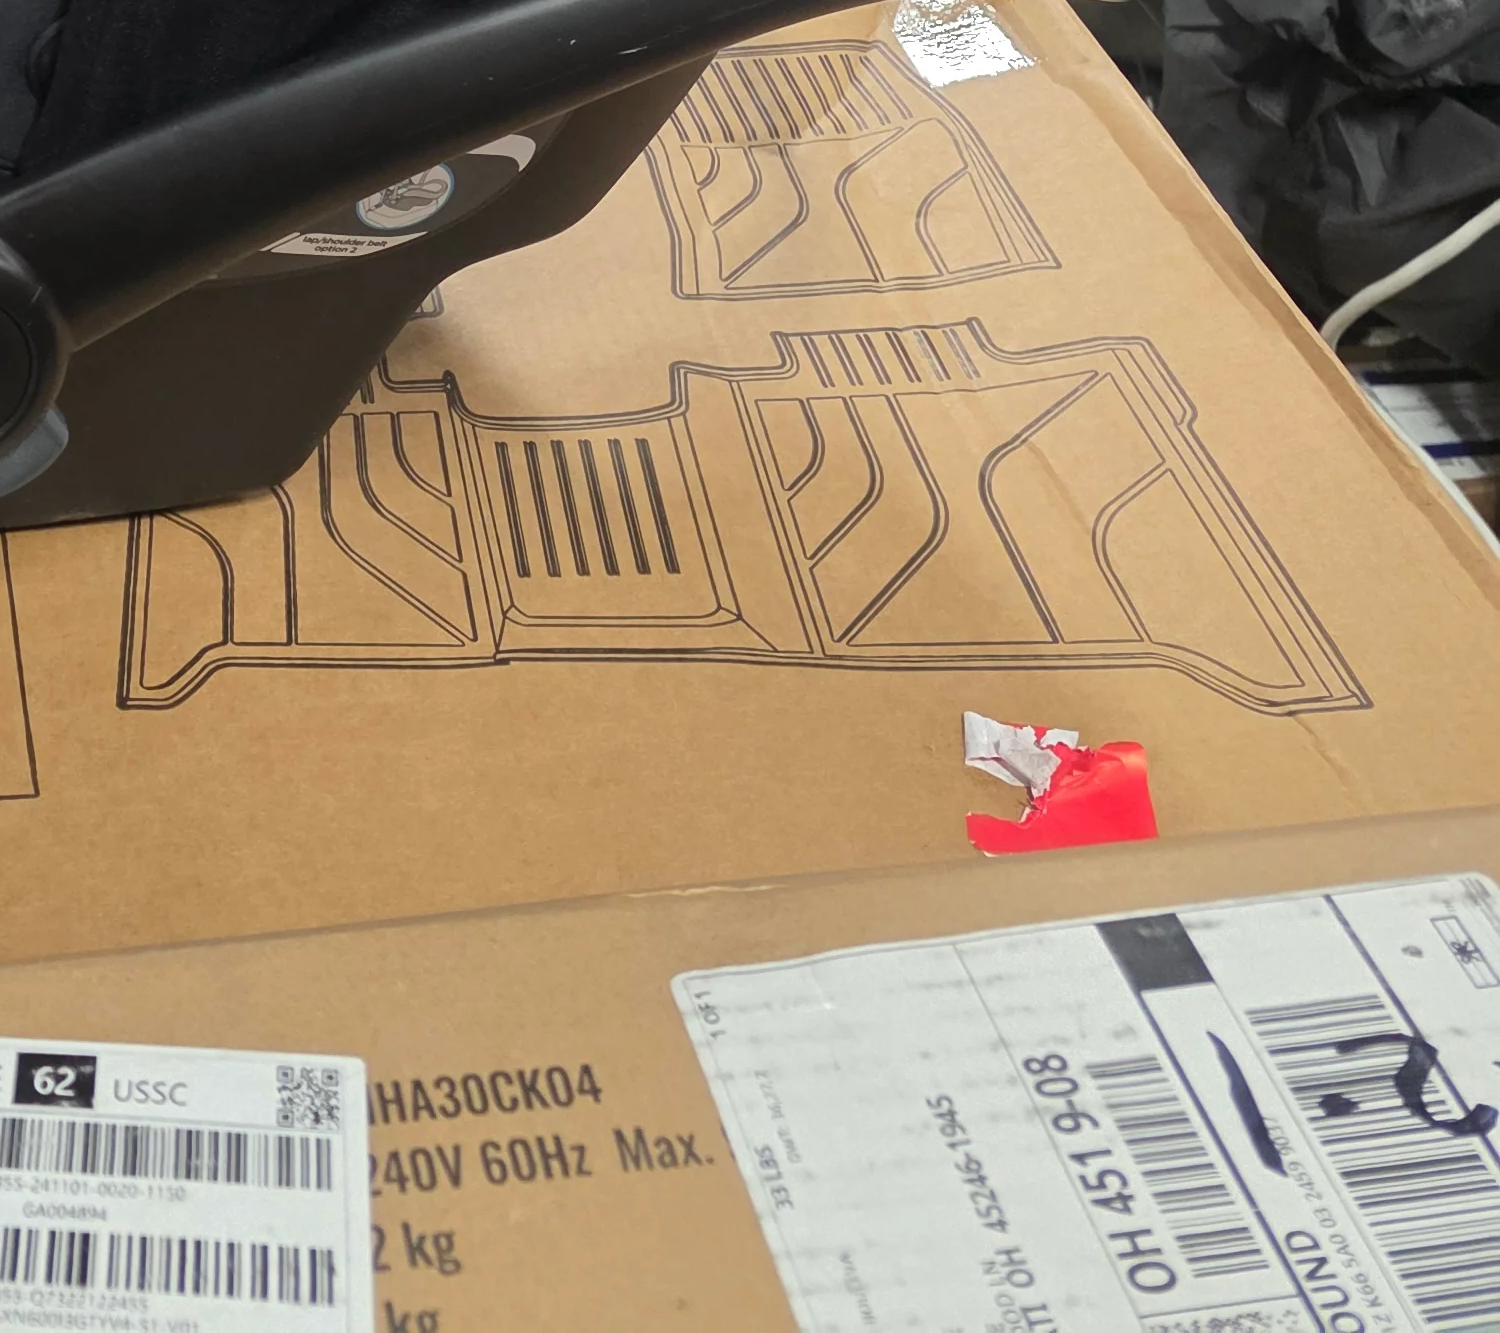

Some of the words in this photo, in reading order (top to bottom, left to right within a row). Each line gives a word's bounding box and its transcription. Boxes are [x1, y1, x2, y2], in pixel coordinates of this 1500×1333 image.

[301, 235, 366, 248] lap/shoulder
[367, 239, 389, 248] belt
[314, 243, 348, 255] option
[349, 246, 358, 254] 2
[32, 1065, 77, 1098] 62
[112, 1079, 190, 1107] USSC
[1022, 1053, 1101, 1136] 9-08
[479, 1134, 593, 1186] 60Hz
[612, 1125, 716, 1174] Max.
[753, 1143, 784, 1184] LBS
[925, 1093, 1011, 1234] 45246-1945
[771, 1183, 795, 1212] 33
[1067, 1148, 1136, 1217] 451
[1287, 1160, 1324, 1203] 2459
[1312, 1206, 1338, 1230] 03
[402, 1220, 463, 1277] kg
[994, 1245, 1036, 1290] OH
[1106, 1227, 1178, 1295] OH
